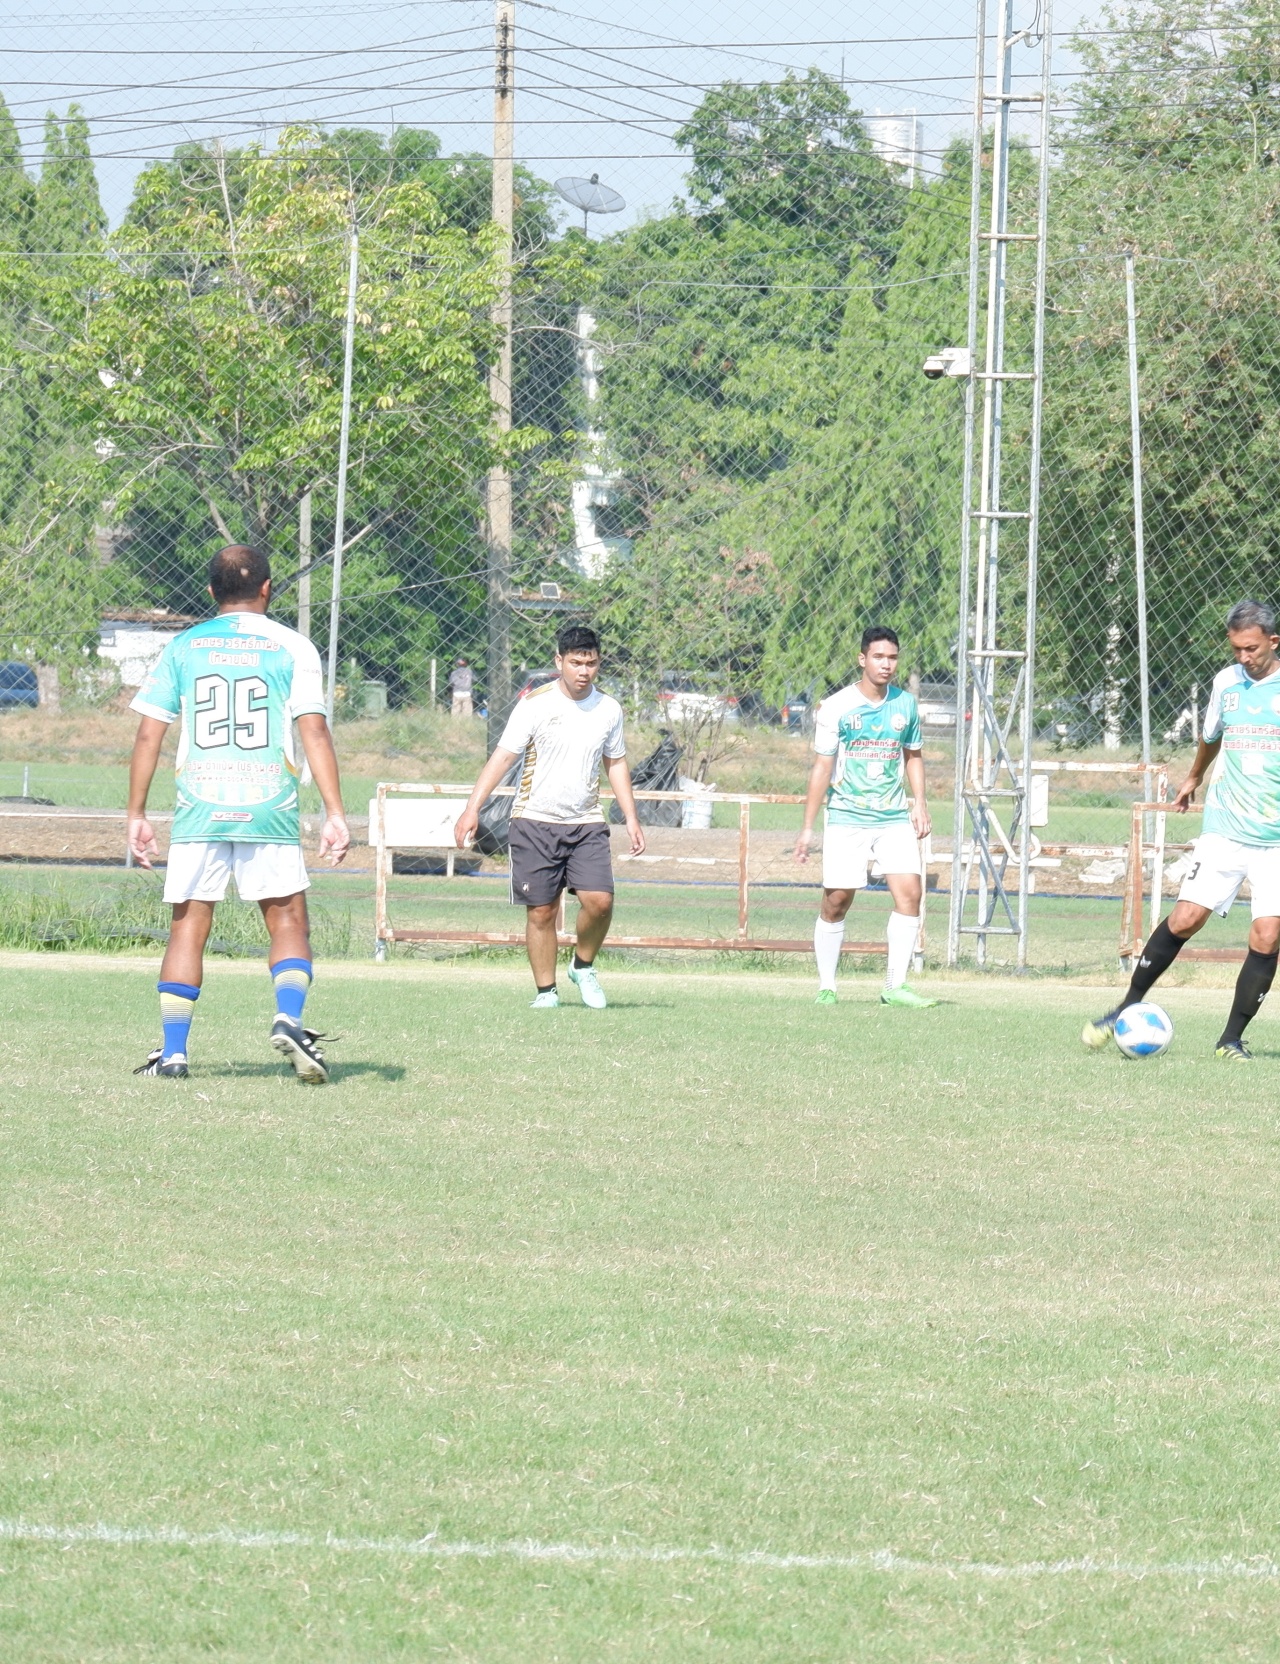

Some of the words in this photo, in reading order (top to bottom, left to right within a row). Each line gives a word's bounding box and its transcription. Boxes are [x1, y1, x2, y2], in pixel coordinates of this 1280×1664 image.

[195, 673, 269, 750] 25
[1223, 692, 1240, 713] 33
[848, 714, 862, 730] 16
